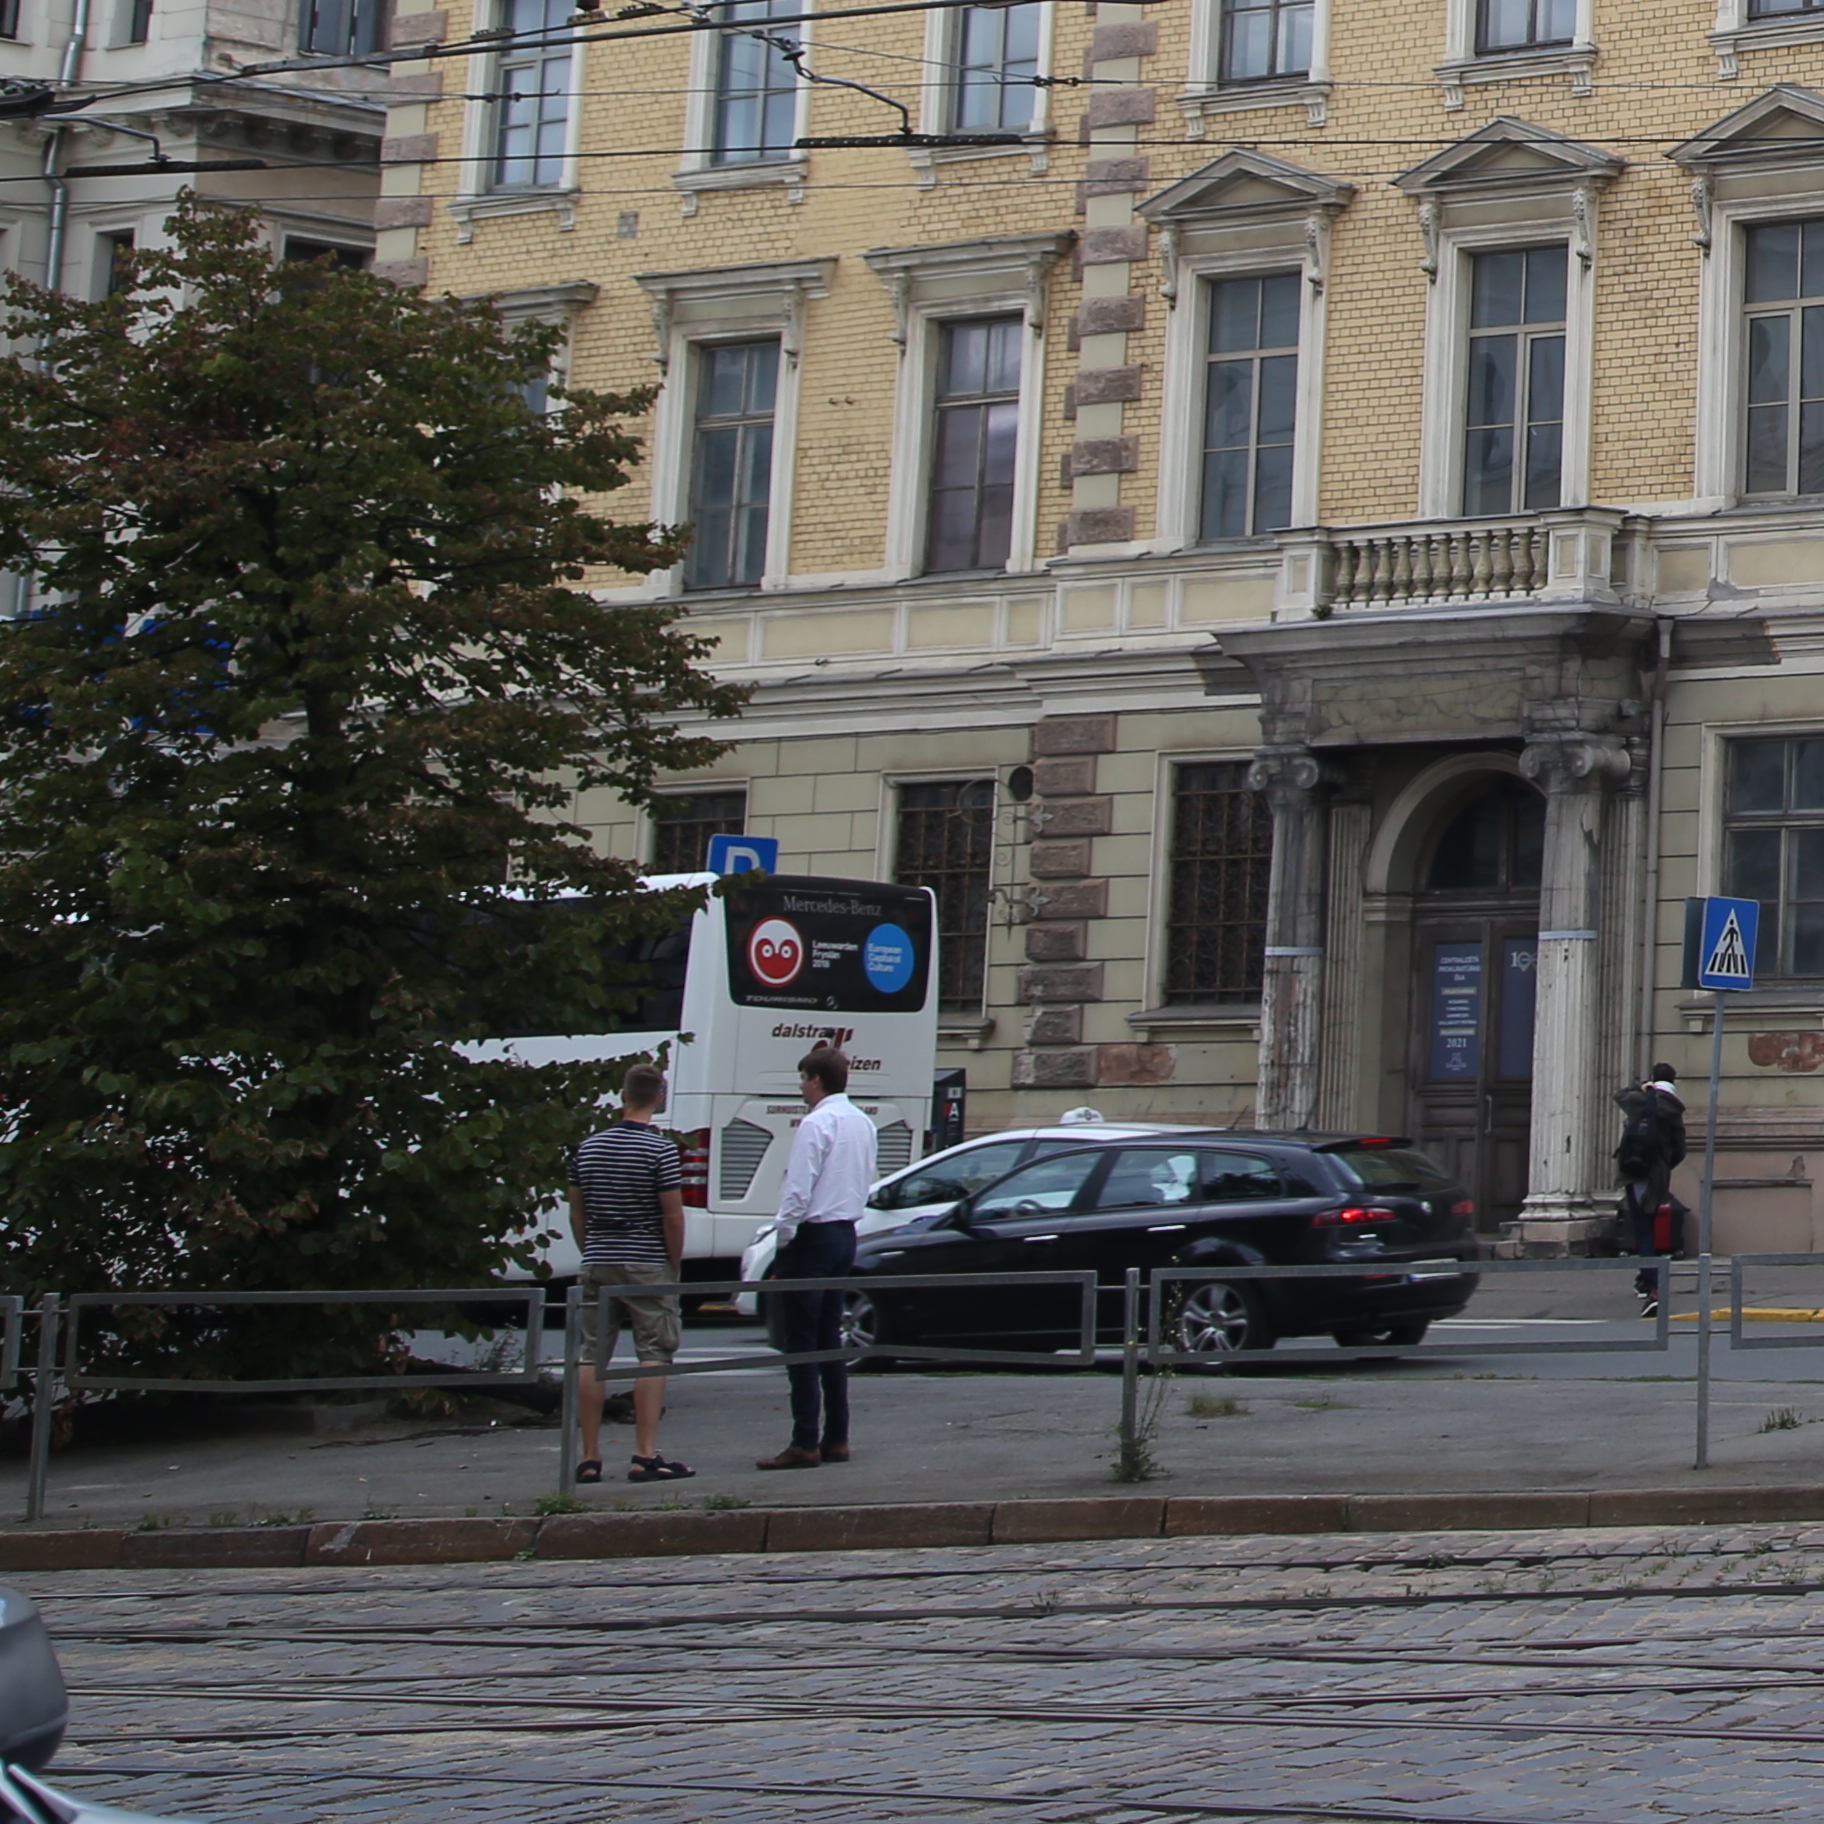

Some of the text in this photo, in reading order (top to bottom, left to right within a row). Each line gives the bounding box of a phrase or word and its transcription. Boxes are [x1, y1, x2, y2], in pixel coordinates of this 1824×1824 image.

[782, 895, 883, 917] Mercedes-Benz
[745, 995, 818, 1004] TOURISMO
[771, 1023, 834, 1039] dalstra
[1446, 1038, 1467, 1048] 2021
[847, 1056, 881, 1071] eizen
